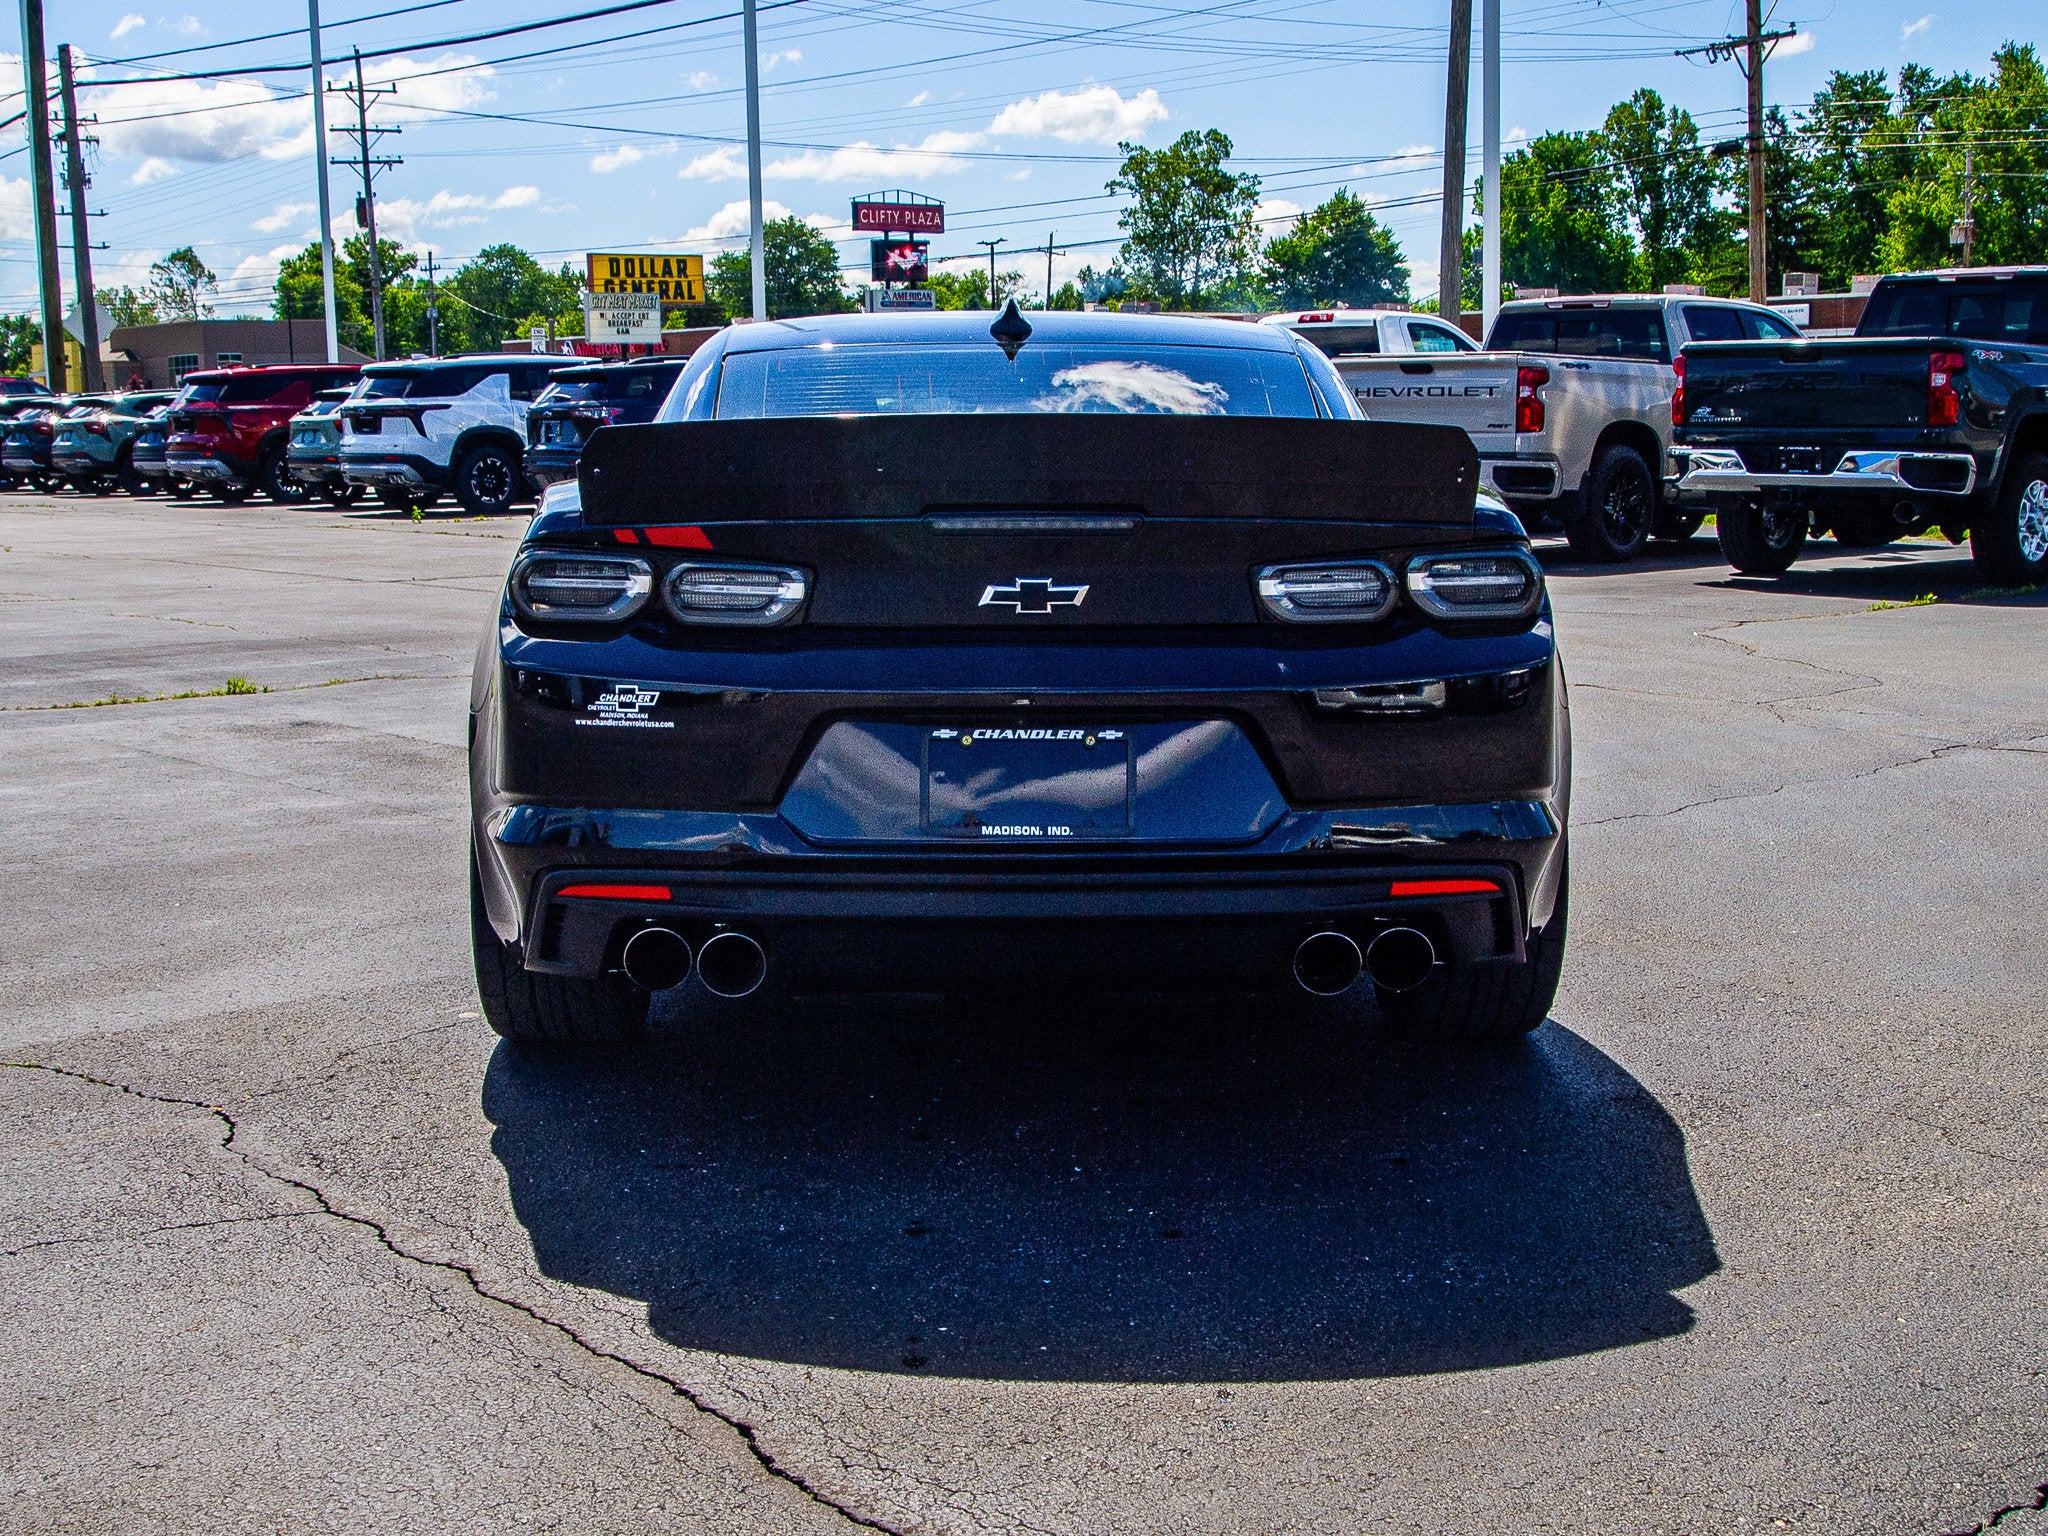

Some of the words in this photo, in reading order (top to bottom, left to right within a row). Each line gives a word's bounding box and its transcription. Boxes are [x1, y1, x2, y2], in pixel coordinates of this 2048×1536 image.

[860, 209, 899, 224] CLIFTY
[904, 211, 941, 225] PLAZA
[608, 257, 688, 278] DOLLAR
[604, 279, 696, 300] GENERAL
[893, 291, 932, 300] AMERICAN
[592, 294, 607, 309] CITY
[607, 294, 628, 308] MEAT
[628, 294, 657, 309] MARKET
[616, 327, 630, 335] 6AM
[575, 342, 622, 356] AMERICA
[1353, 386, 1500, 398] HEVROLET
[600, 693, 651, 703] CHANDLER
[575, 718, 675, 728] www.chandlerchevroletusa.com
[972, 729, 1084, 740] CHANDLER
[1047, 825, 1073, 836] IND.
